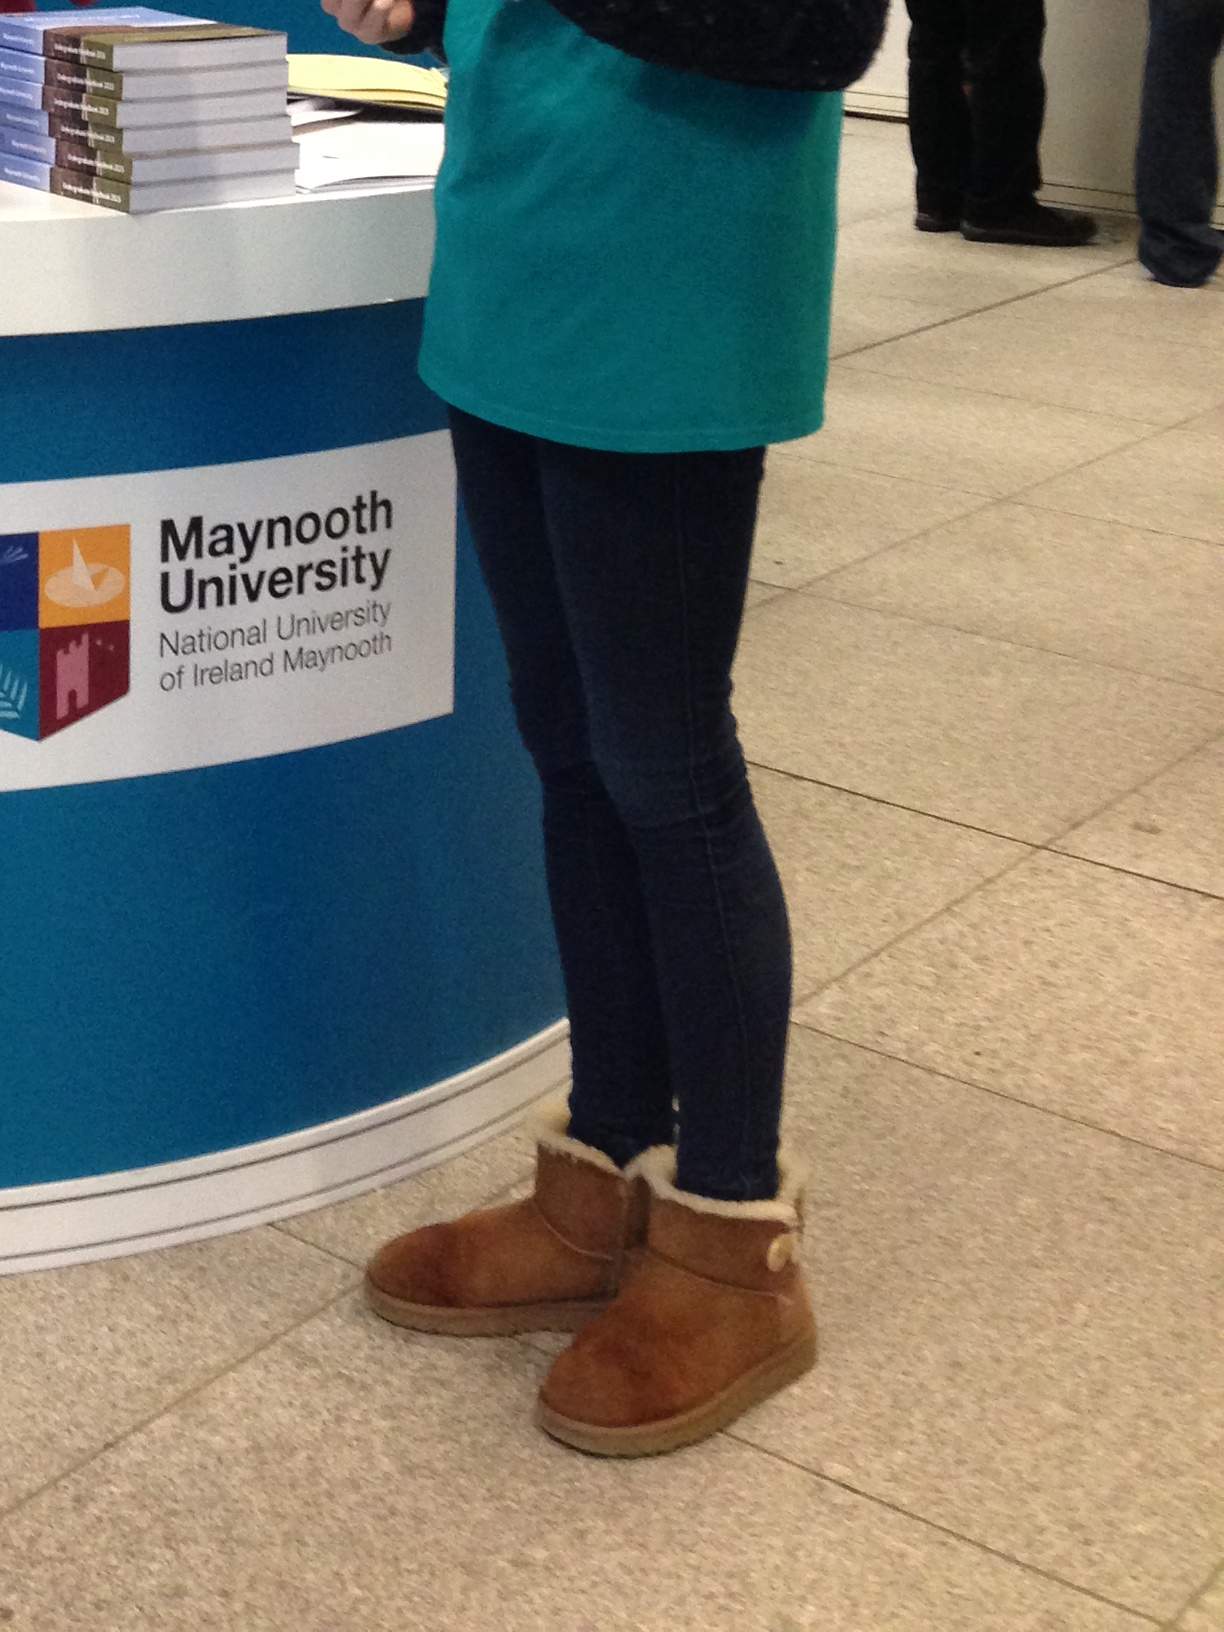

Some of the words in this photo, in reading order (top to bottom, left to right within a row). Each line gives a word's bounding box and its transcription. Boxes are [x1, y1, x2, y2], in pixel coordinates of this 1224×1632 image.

[160, 490, 393, 564] Maynooth
[160, 545, 392, 614] University
[160, 618, 268, 658] National
[277, 599, 392, 641] University
[160, 668, 185, 692] of
[192, 652, 274, 687] Ireland
[283, 631, 392, 672] Maynooth
